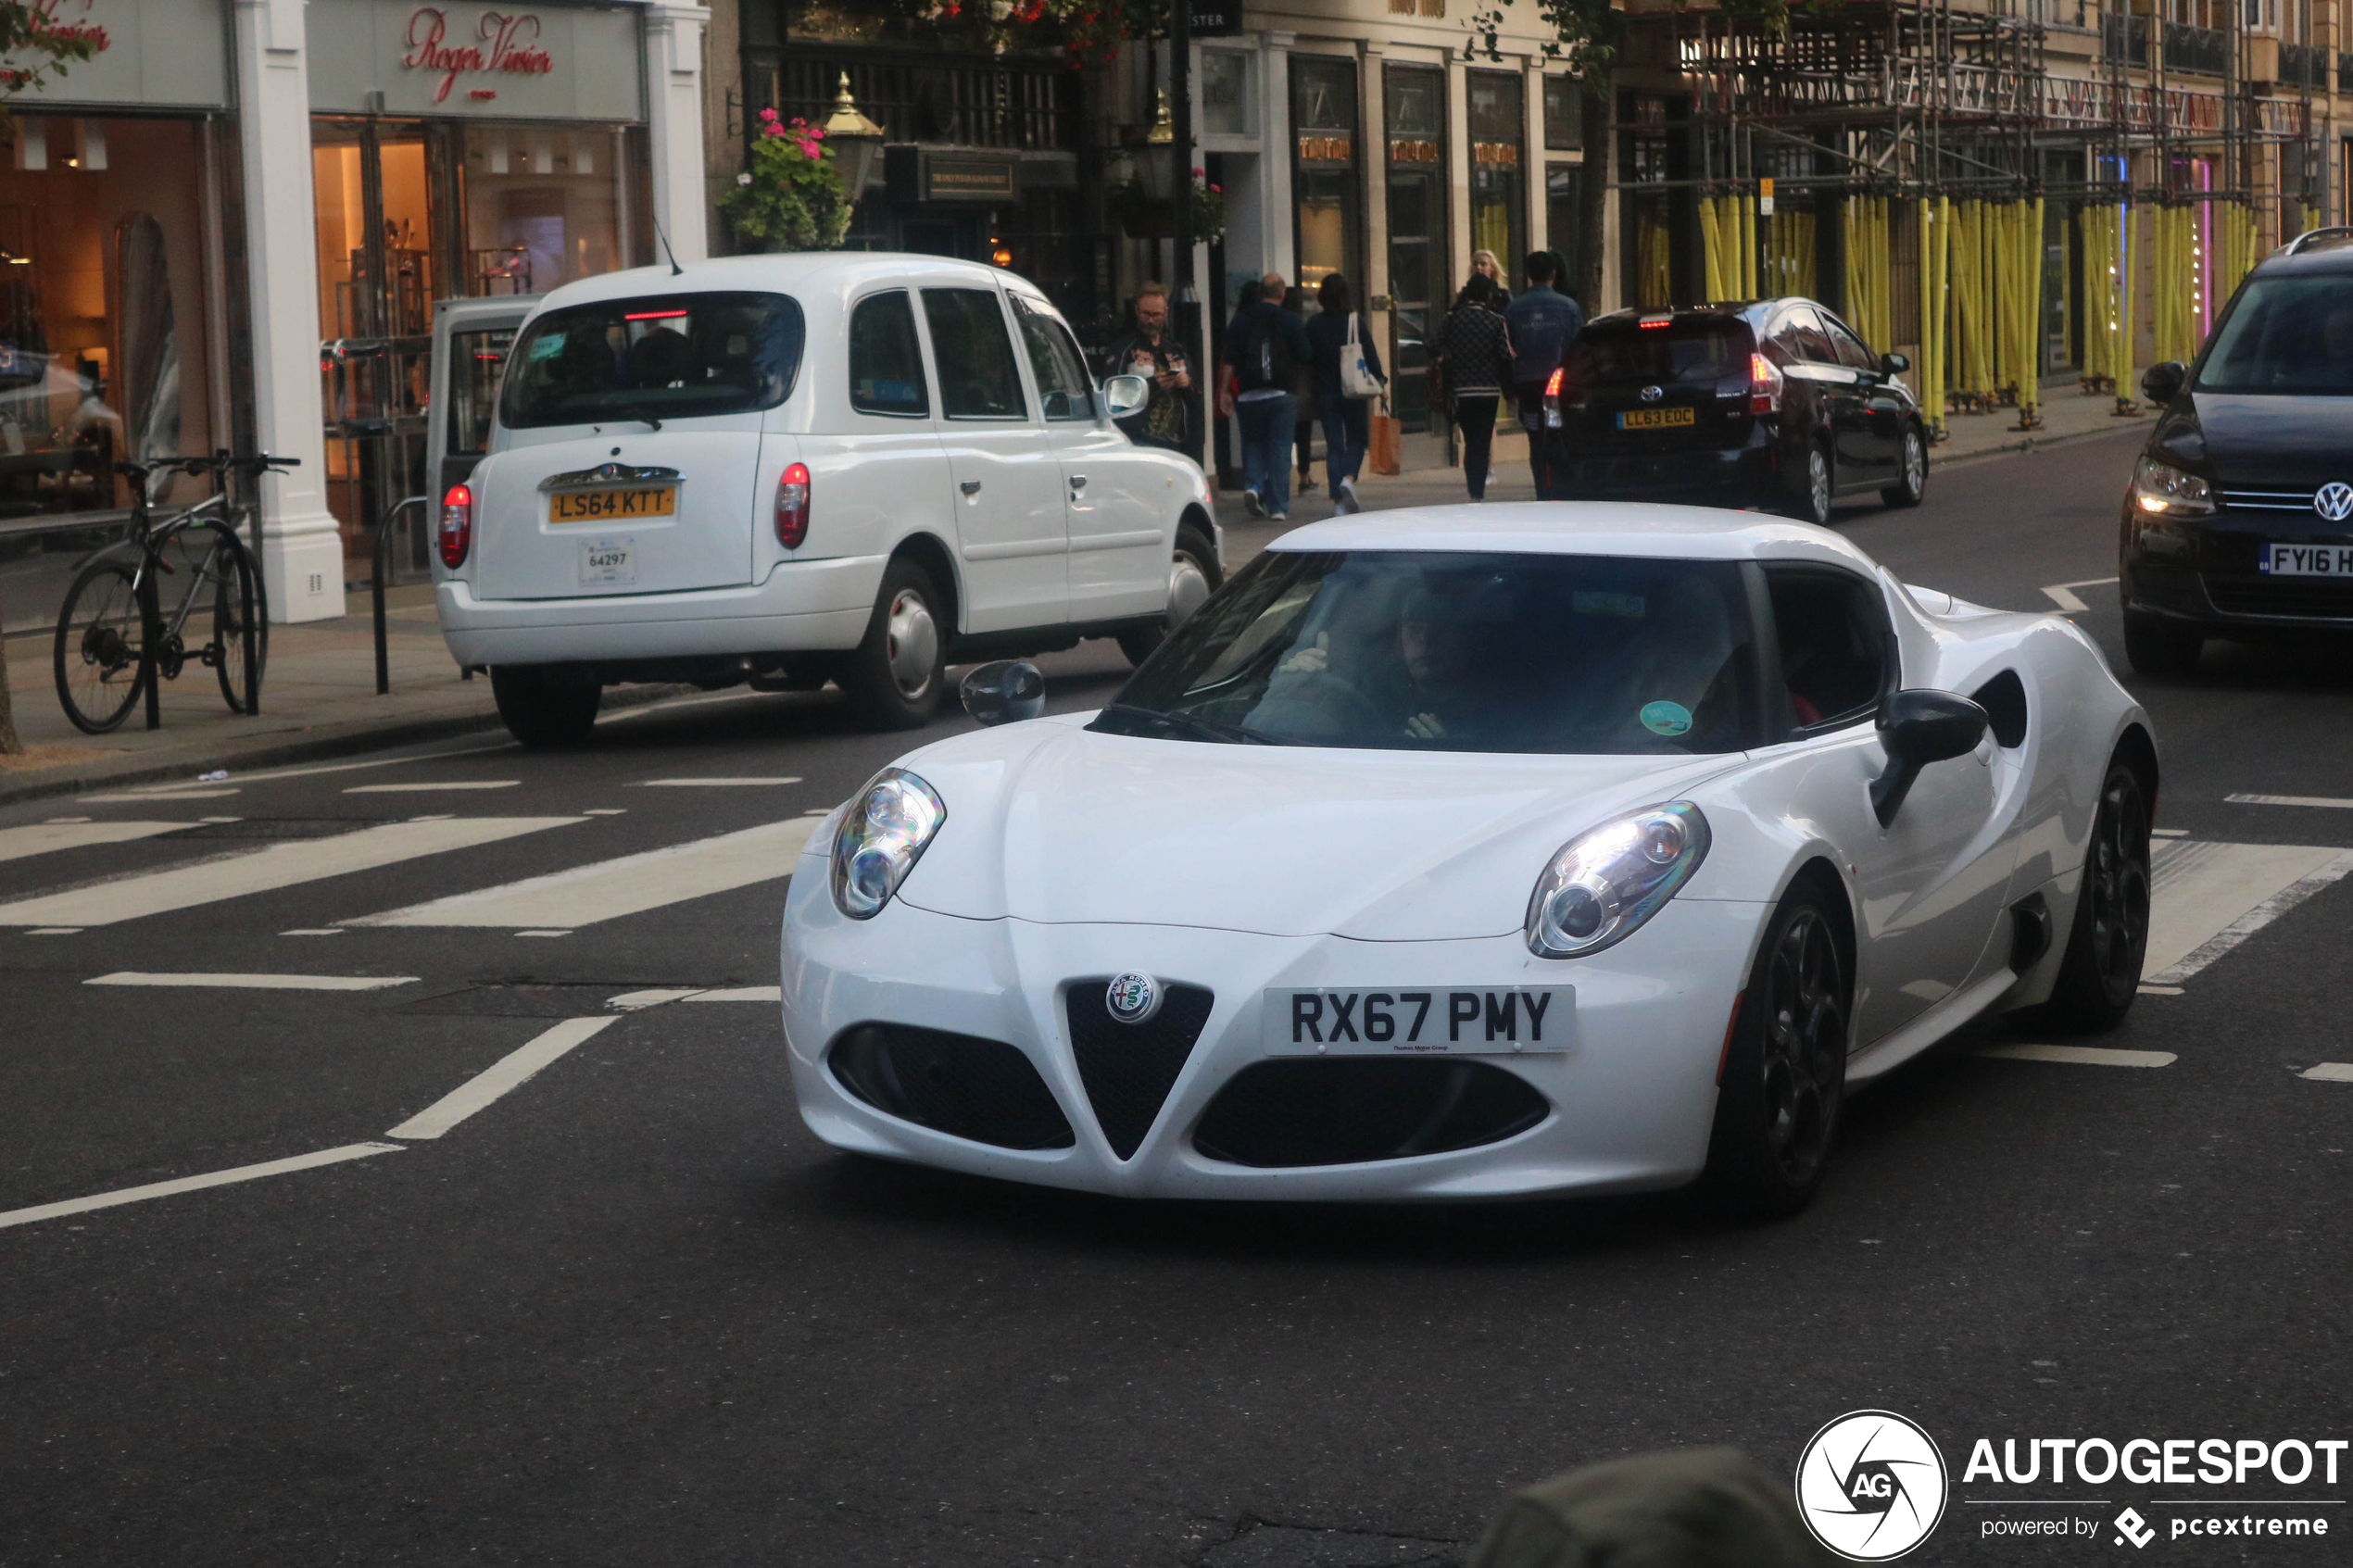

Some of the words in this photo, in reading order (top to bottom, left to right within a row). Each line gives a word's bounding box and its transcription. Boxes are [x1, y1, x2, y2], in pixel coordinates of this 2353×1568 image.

[1191, 14, 1224, 26] STER
[406, 8, 484, 102] Roger
[481, 11, 553, 73] Vivier
[1626, 410, 1661, 426] LL63
[1665, 408, 1692, 423] EOC
[560, 493, 616, 518] LS64
[623, 490, 665, 514] KTT
[589, 553, 626, 567] 64297
[2274, 548, 2330, 572] FY16
[1112, 978, 1126, 995] ALFA
[1128, 975, 1149, 997] ROMEO
[1292, 993, 1431, 1042] RX67
[1449, 992, 1552, 1042] PMY
